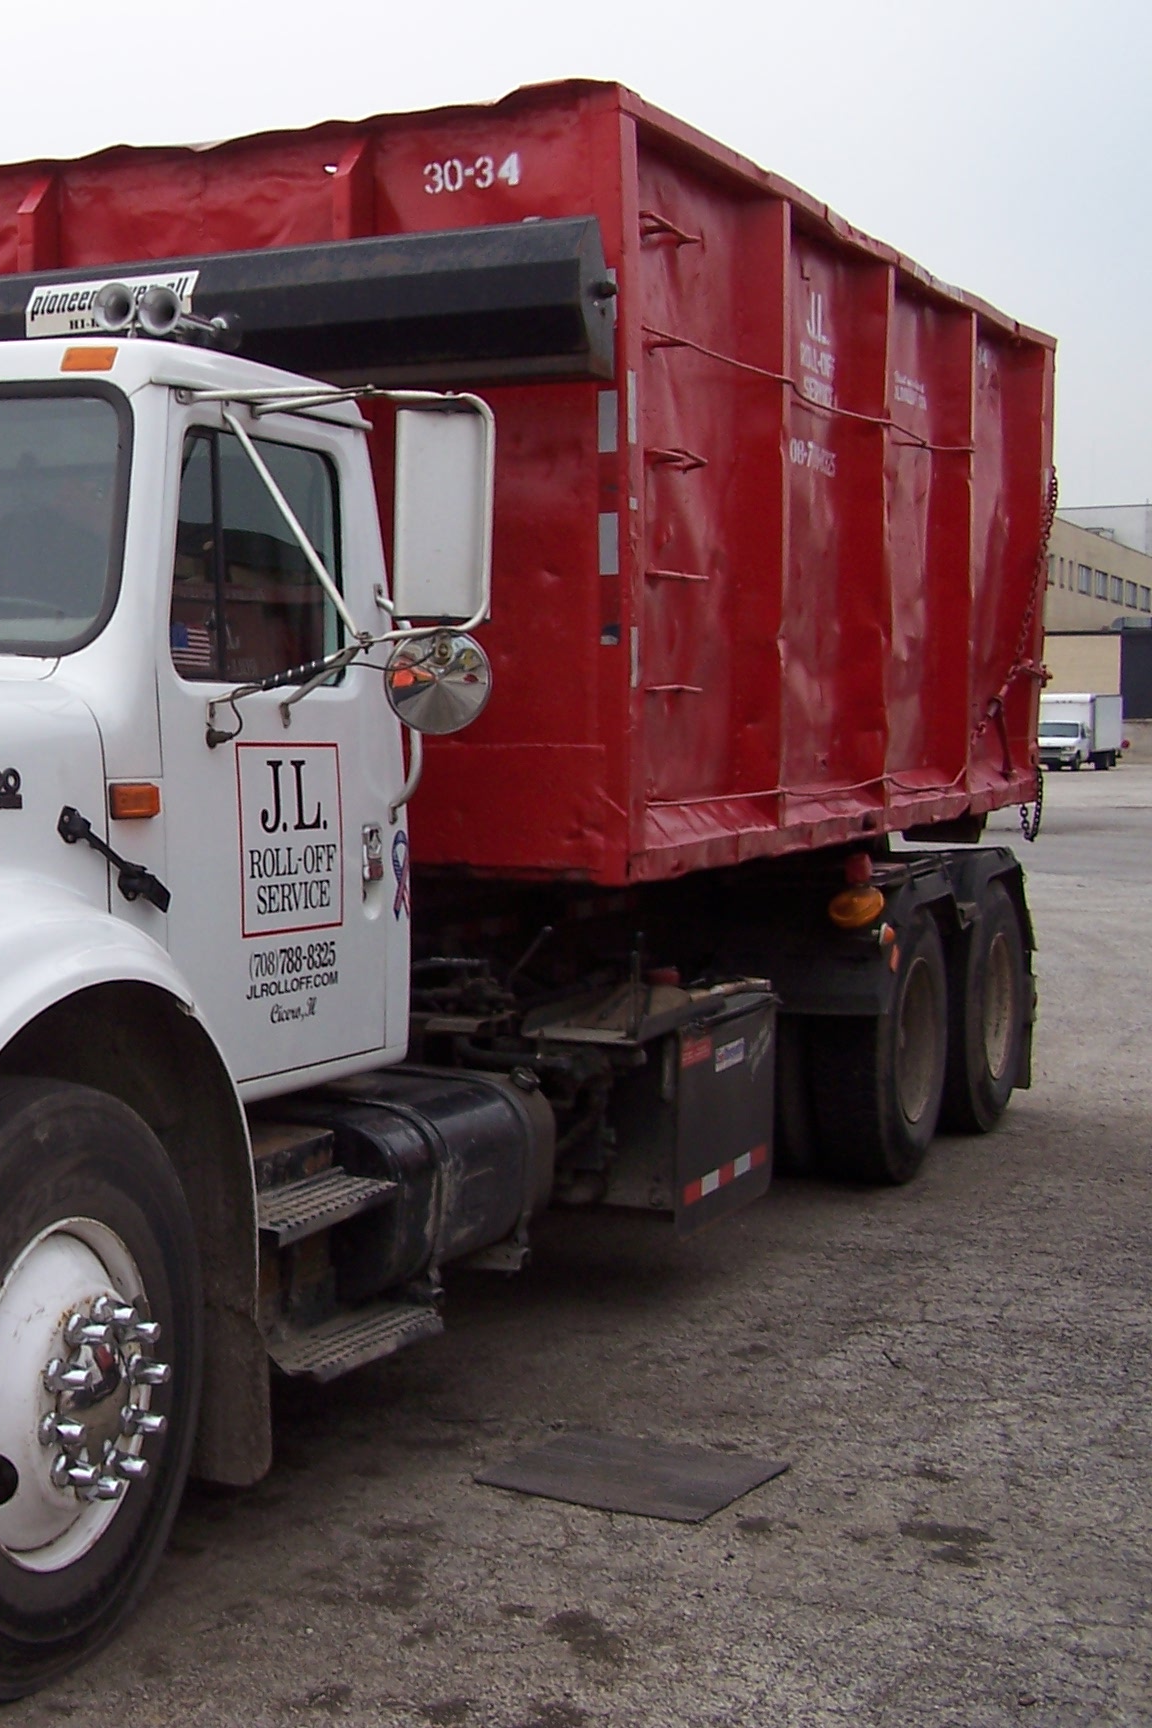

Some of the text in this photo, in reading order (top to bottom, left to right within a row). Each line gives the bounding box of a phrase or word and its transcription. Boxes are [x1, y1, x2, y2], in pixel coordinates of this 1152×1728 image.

[423, 152, 520, 194] 30-34
[30, 290, 99, 321] pioneer
[260, 760, 328, 834] J.L.
[249, 843, 337, 879] ROLL-OFF
[256, 879, 331, 916] SERVICE
[246, 971, 339, 1001] JLROLLOFF.COM
